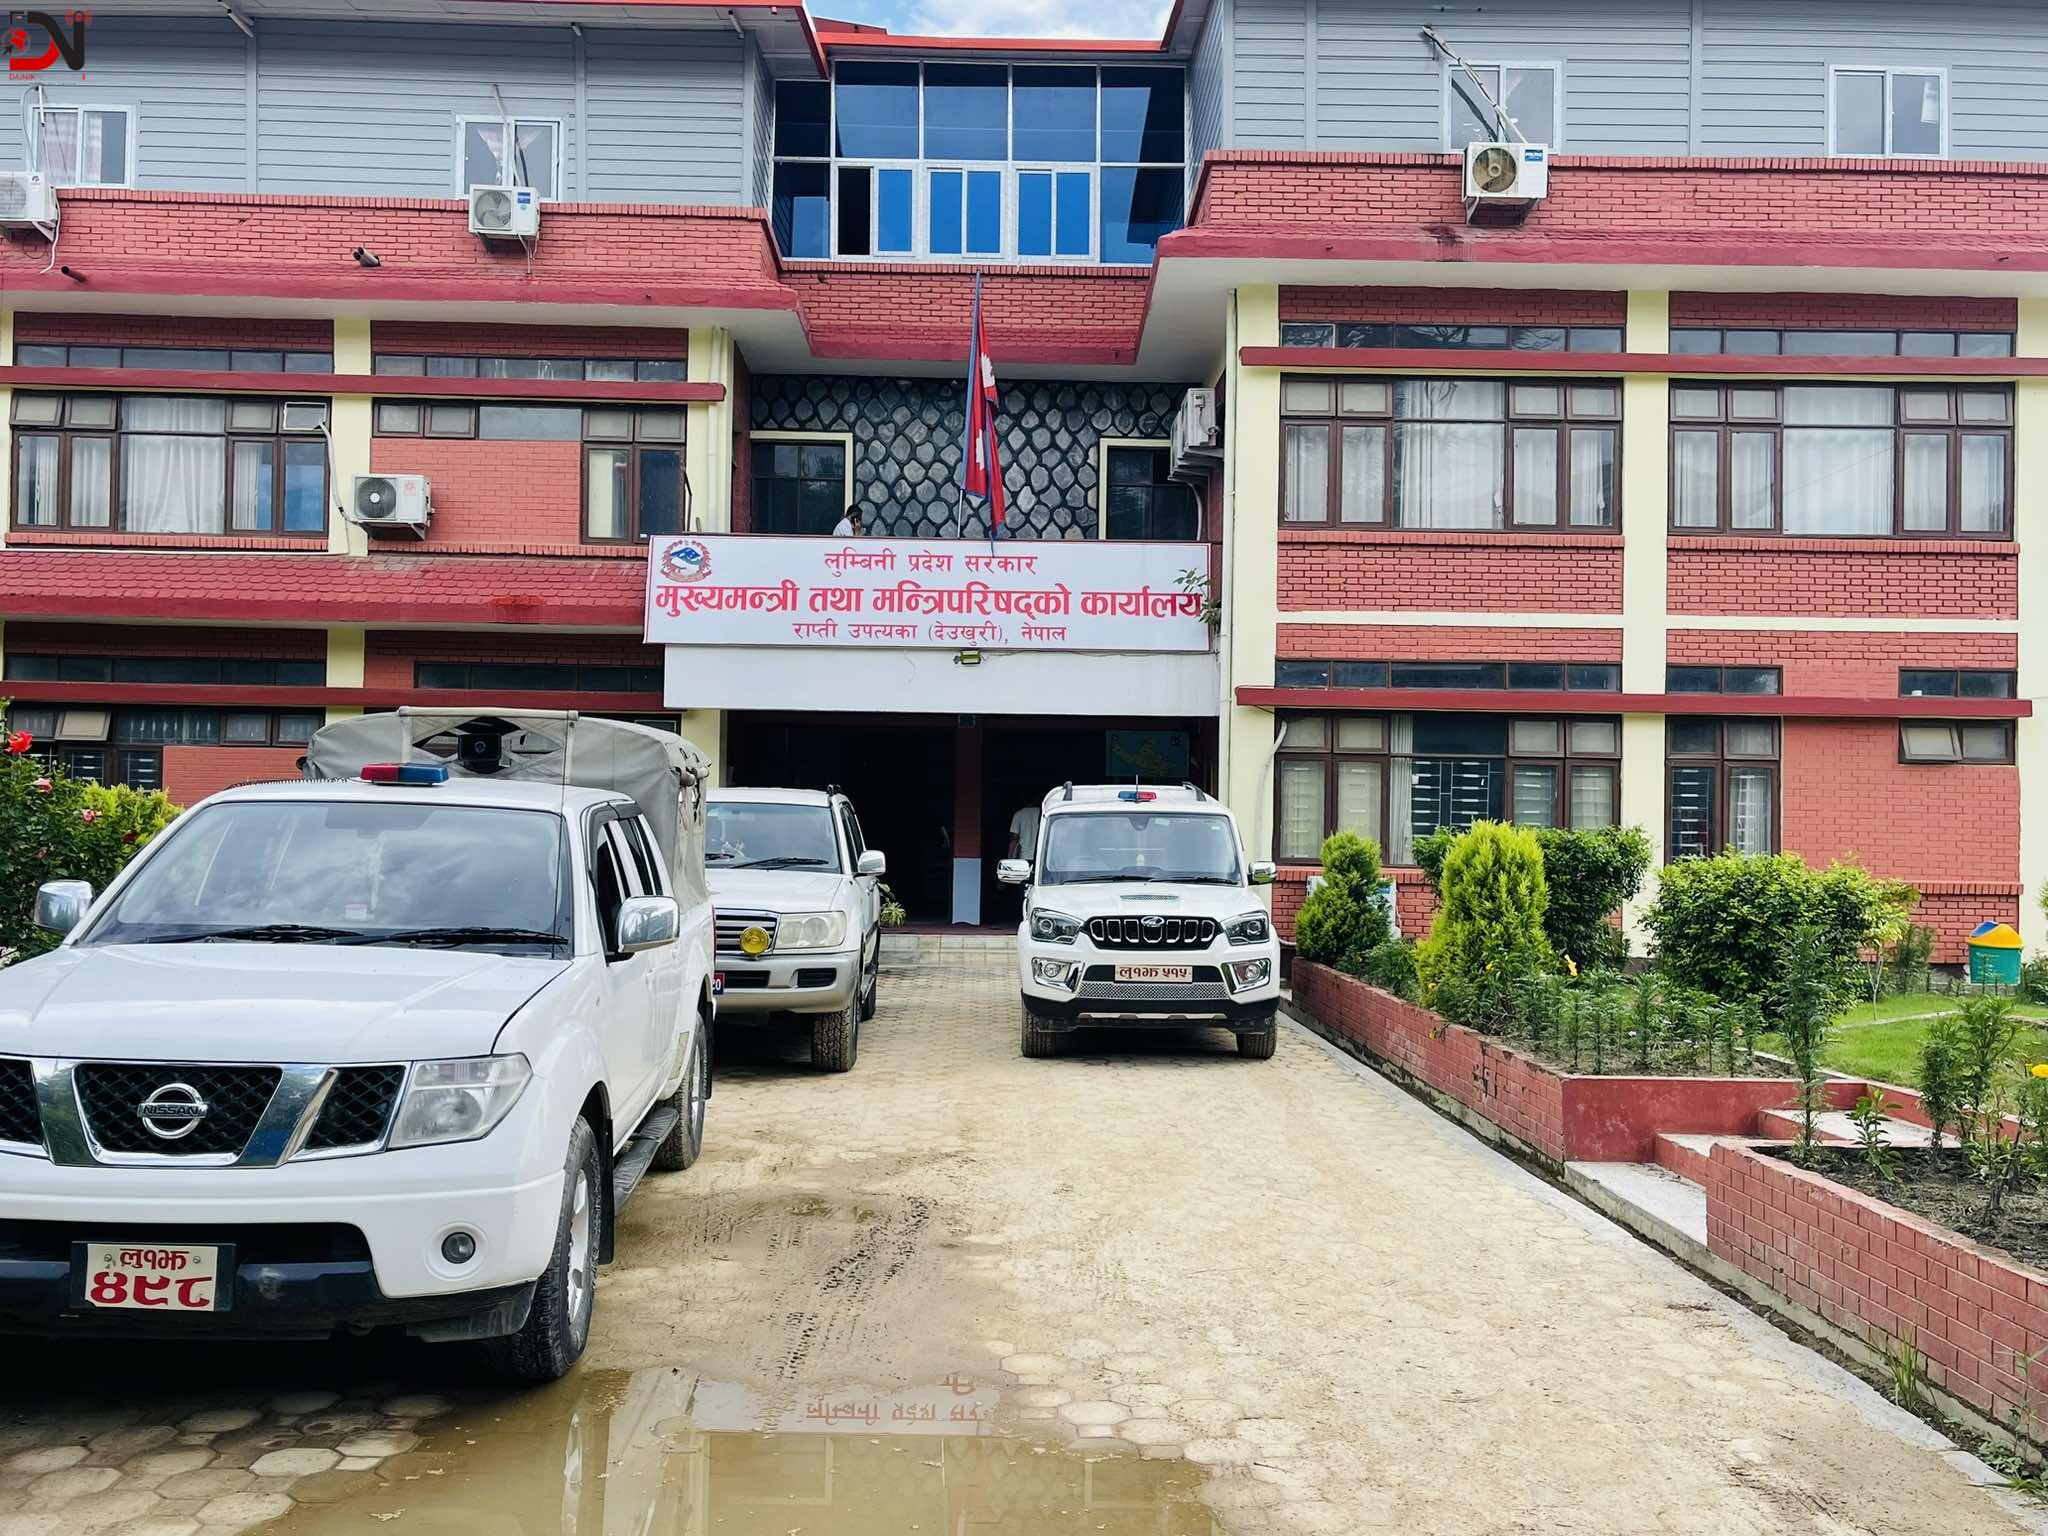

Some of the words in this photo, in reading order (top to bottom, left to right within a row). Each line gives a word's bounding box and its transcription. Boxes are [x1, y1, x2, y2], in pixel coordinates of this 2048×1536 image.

[824, 546, 896, 578] लुम्बिनी
[908, 550, 953, 573] प्रदेश
[965, 555, 1038, 575] सरकार
[656, 579, 800, 618] मुख्यमन्त्री
[809, 586, 864, 613] तथा
[872, 579, 1072, 620] मन्त्रिपरिषद्को
[1080, 585, 1203, 618] कार्यालय
[792, 617, 838, 639] राप्ती
[848, 623, 918, 641] उपत्यका
[928, 620, 1008, 646] (देउखुरी),
[1021, 621, 1067, 641] नेपाल
[143, 1105, 199, 1115] NISSAN
